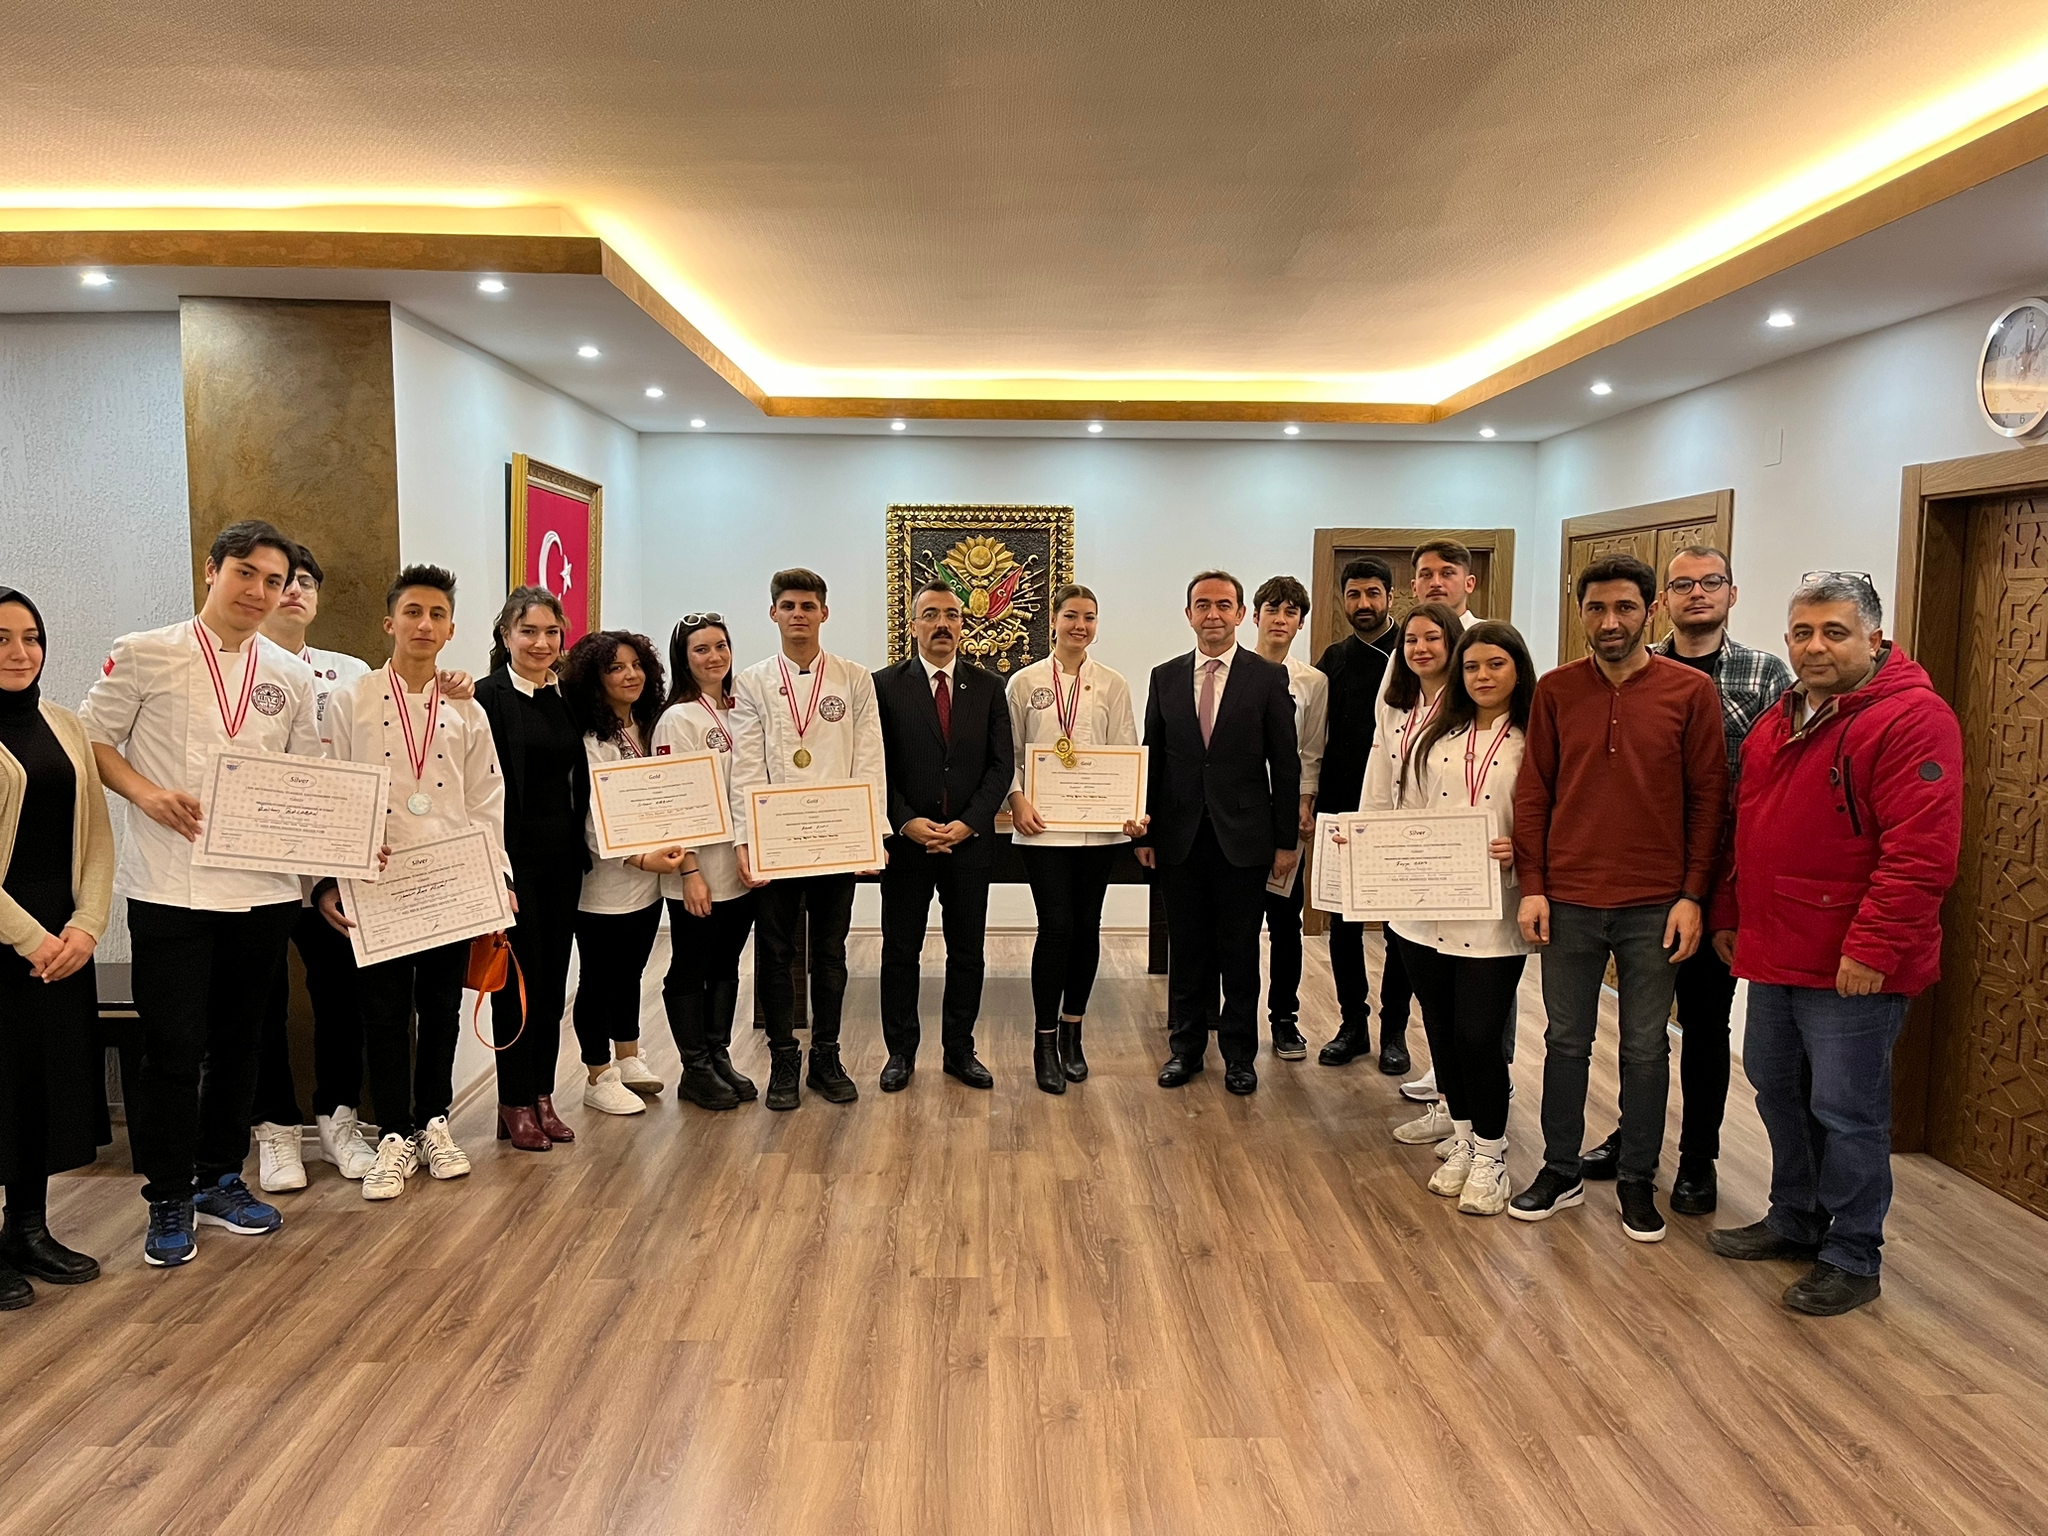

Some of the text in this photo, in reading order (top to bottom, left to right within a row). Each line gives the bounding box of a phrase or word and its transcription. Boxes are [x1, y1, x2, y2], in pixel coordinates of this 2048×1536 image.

[2025, 311, 2034, 323] 12
[1997, 345, 2007, 357] 10
[1993, 392, 1999, 403] 8
[2019, 413, 2025, 424] 6
[289, 776, 309, 784] Silver
[411, 858, 428, 867] Silver
